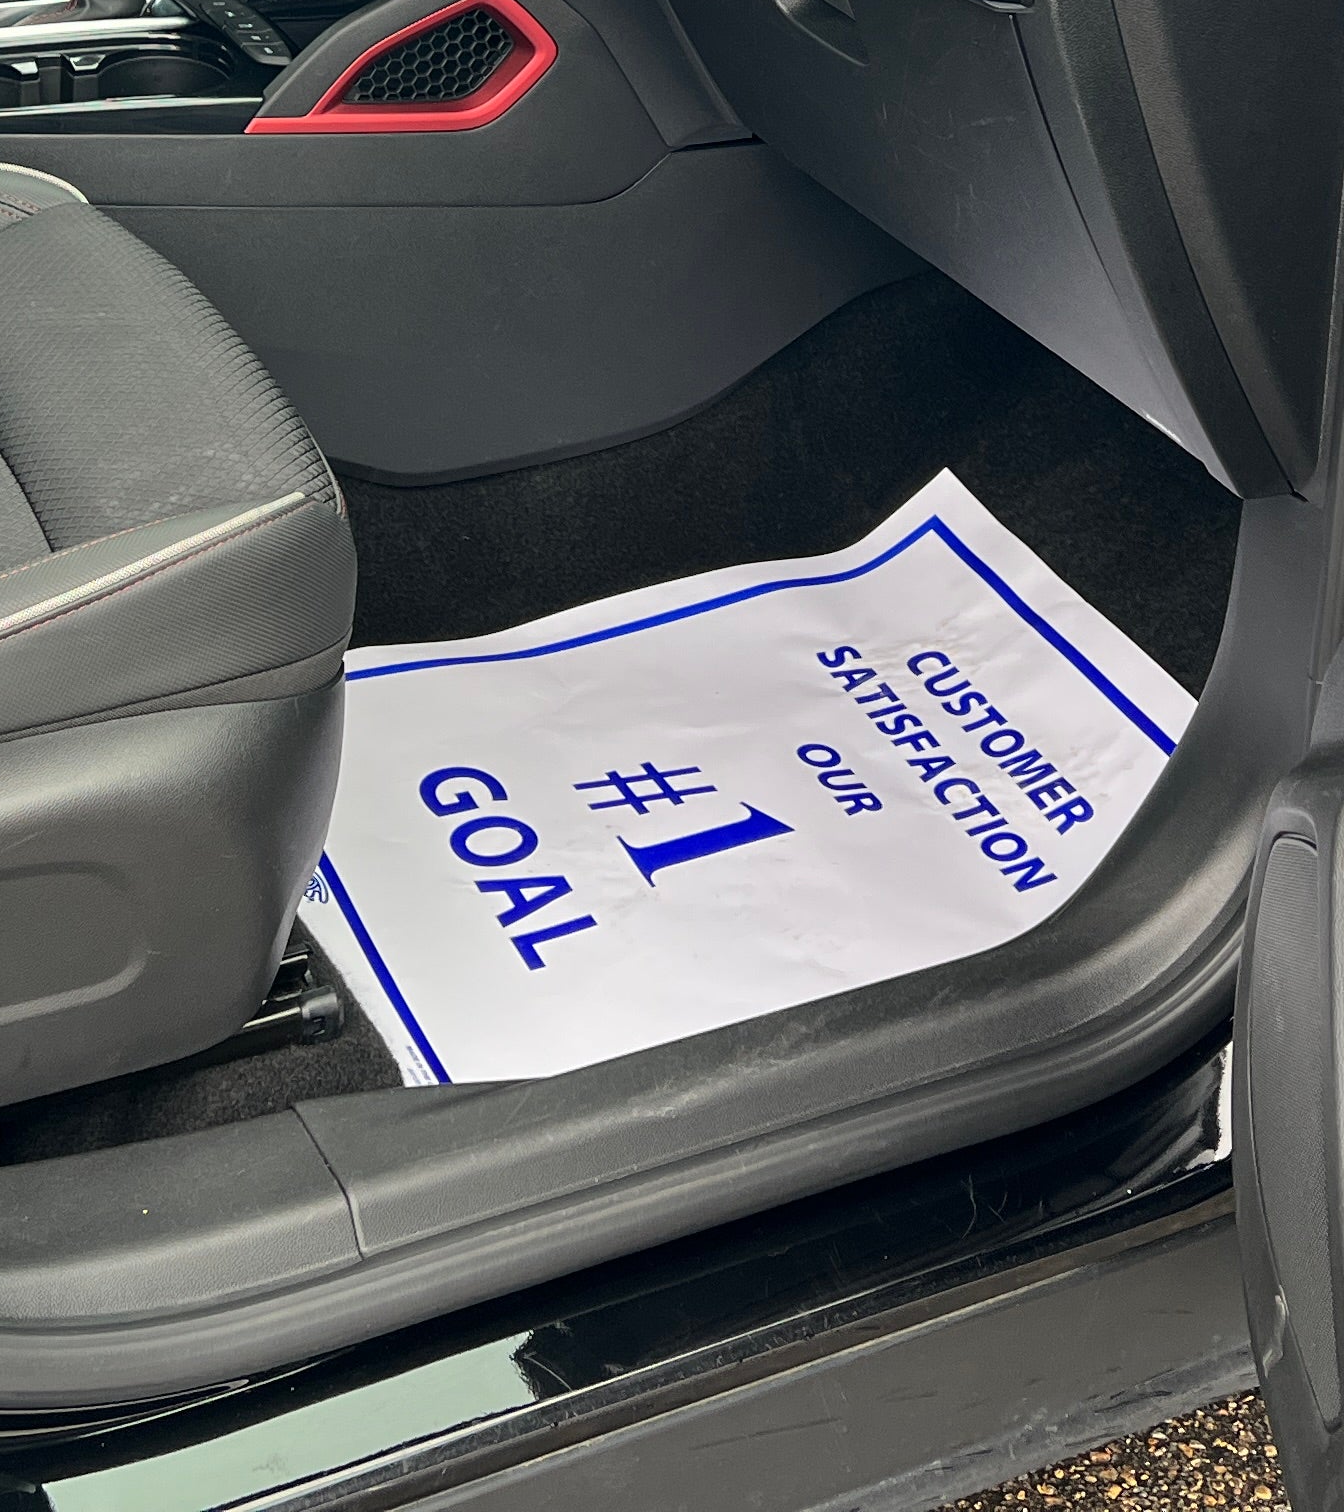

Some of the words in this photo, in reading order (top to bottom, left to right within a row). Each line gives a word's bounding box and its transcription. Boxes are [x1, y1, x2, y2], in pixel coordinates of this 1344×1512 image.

[572, 761, 796, 888] #1
[795, 742, 884, 816] OUR
[816, 645, 1058, 893] SATISFACTION
[906, 650, 1096, 836] CUSTOMER
[418, 765, 598, 971] GOAL
